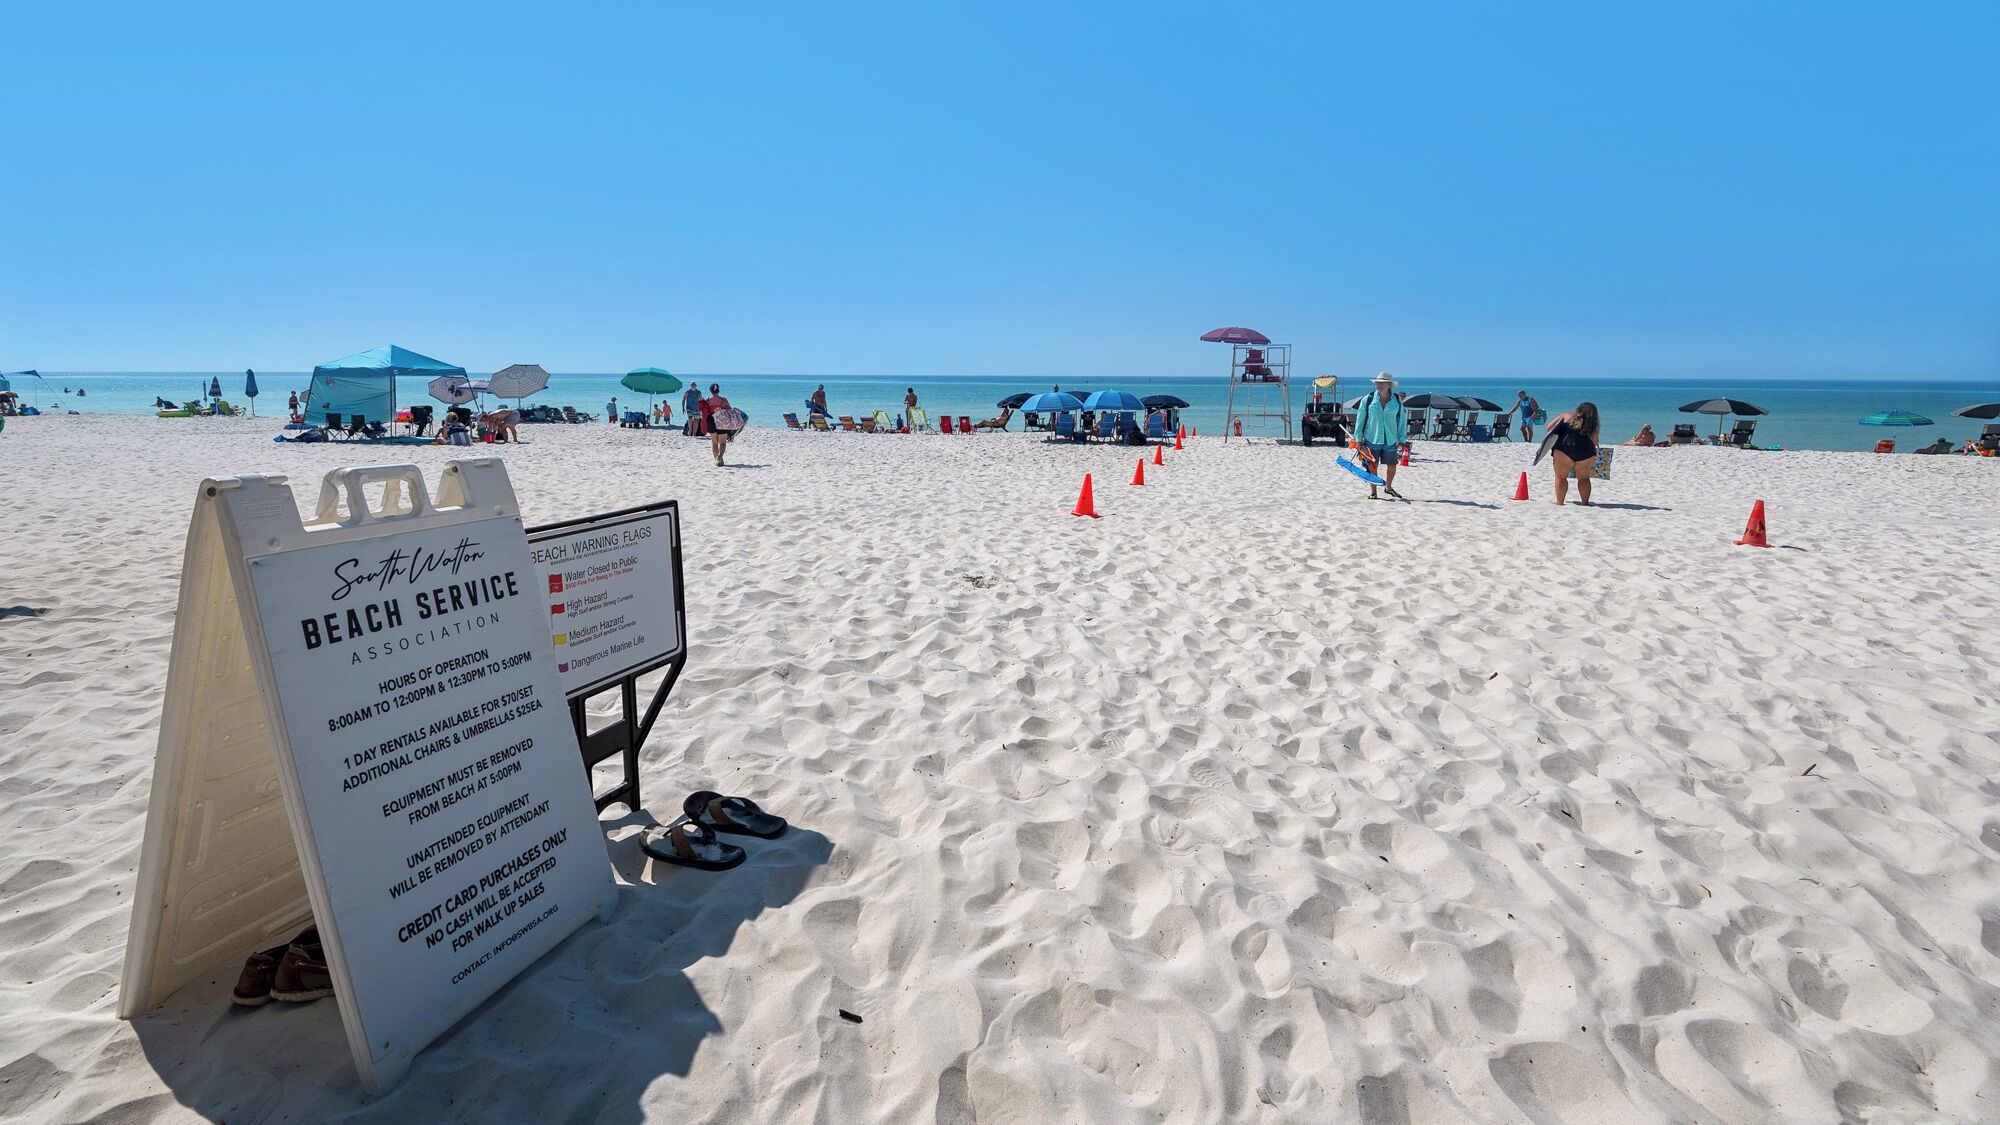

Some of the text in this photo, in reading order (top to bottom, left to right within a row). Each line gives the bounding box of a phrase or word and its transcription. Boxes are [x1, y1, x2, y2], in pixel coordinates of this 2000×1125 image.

[331, 538, 485, 600] South Walton
[531, 527, 651, 564] BEACH WARNING FLAGS
[565, 570, 585, 582] Water
[587, 562, 610, 576] Closed
[620, 556, 638, 567] Public
[301, 572, 518, 650] BEACH SERVICE
[567, 590, 607, 611] High Hazard
[569, 614, 624, 641] Medium Hazard
[352, 612, 499, 665] ASSOCIATION
[379, 649, 489, 694] HOURS OF OPERATION
[572, 635, 644, 669] Dangerous Marine Life
[329, 651, 531, 731] 8:00AM TO 12:00PM & 12:30PM TO 5:00PM
[344, 685, 533, 769] 1 DAY RENTALS AVAILABLE FOR $70/SET
[343, 699, 542, 792] ADDITIONAL CHAIRS & UMBRELLAS $25EA
[383, 738, 533, 817] EQUIPMENT MUST BE REMOVED
[408, 761, 522, 825] FROM BEACH AT 5:00PM
[389, 800, 550, 899] WILL BE REMOVED BY ATTENDANT
[407, 793, 530, 868] UNATTENDED EQUIPMENT
[398, 828, 567, 943] CREDIT CARD PURCHASES ONLY
[425, 857, 556, 948] NO CASH WILL BE ACCEPTED
[452, 882, 545, 952] FOR WALK UP SALES
[452, 904, 559, 984] CONTACT: INFO@SWBSA.ORG
